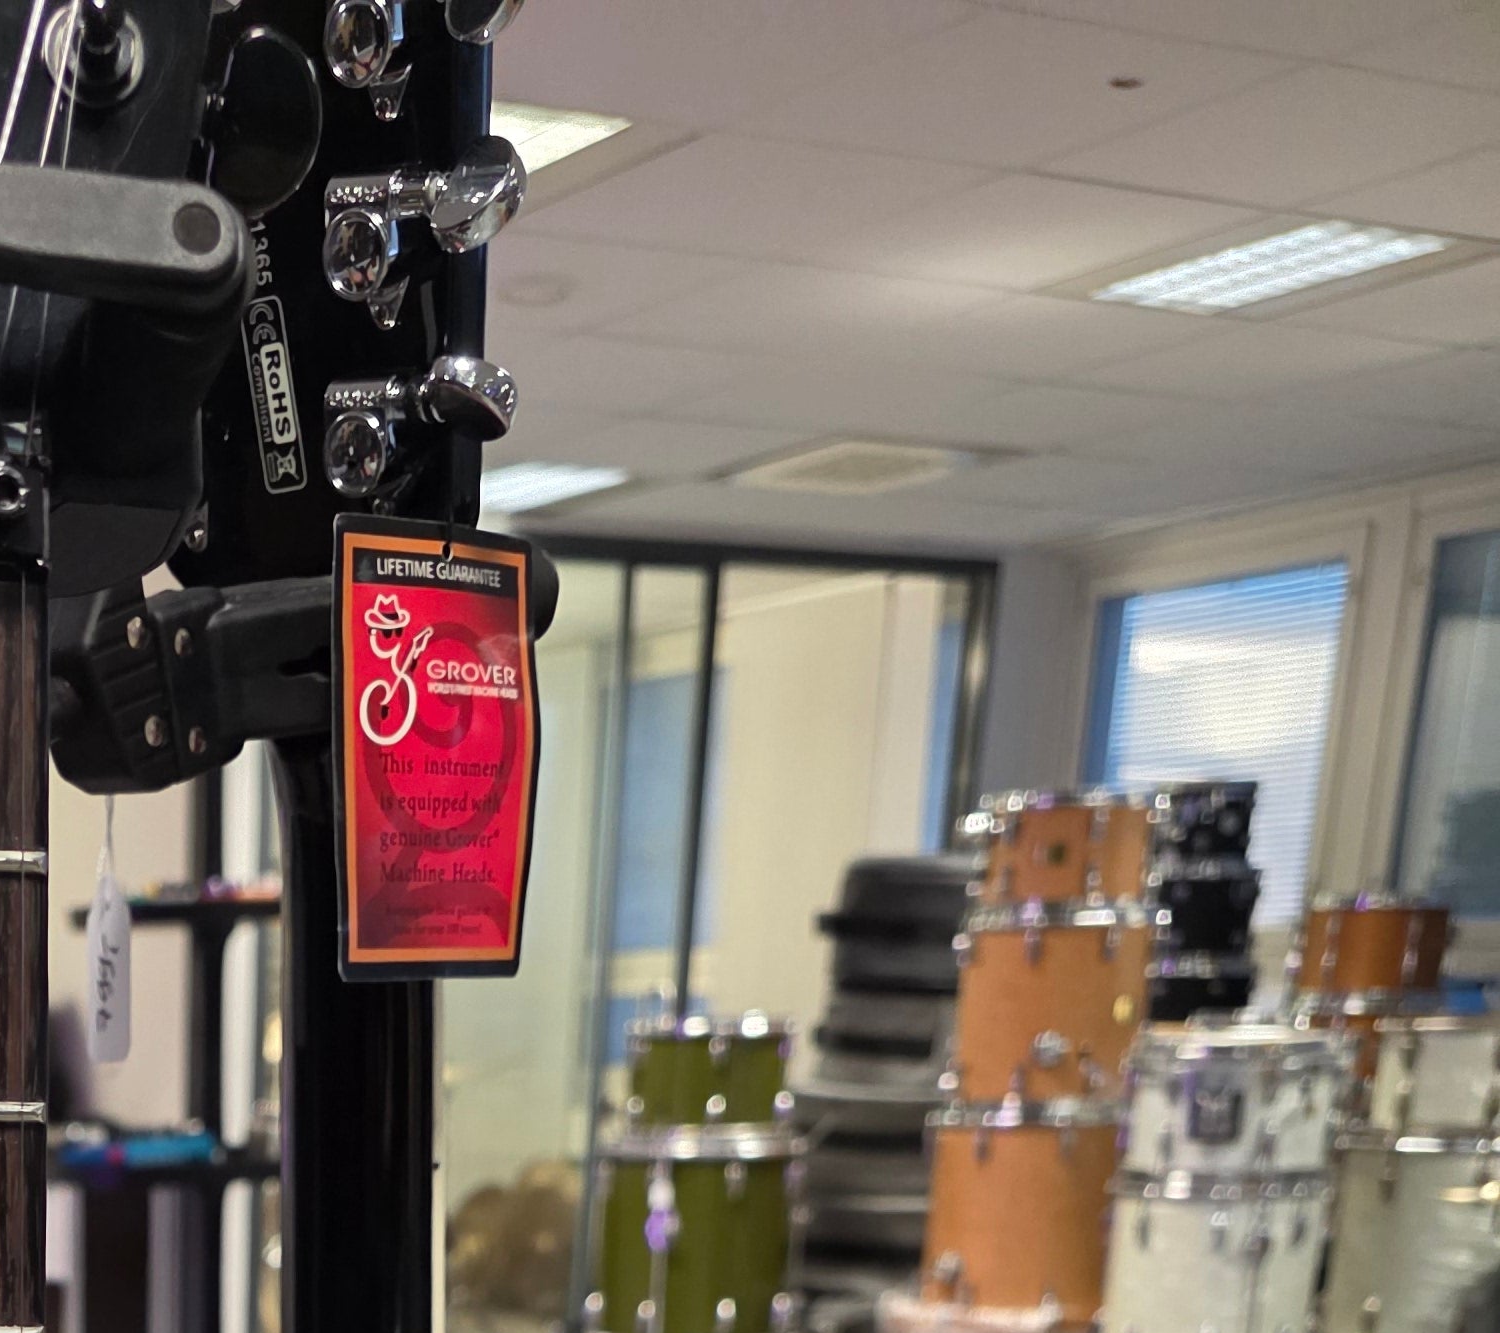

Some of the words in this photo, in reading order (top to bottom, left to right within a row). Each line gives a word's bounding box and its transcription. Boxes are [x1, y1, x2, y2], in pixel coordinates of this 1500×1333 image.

[264, 349, 291, 438] RoHS
[376, 557, 435, 579] LIFETIME
[436, 562, 501, 588] GUARANTEE
[426, 659, 517, 686] GROVER
[379, 752, 414, 775] This
[398, 791, 469, 818] equipped
[379, 829, 441, 852] genuine
[380, 860, 445, 883] Machine
